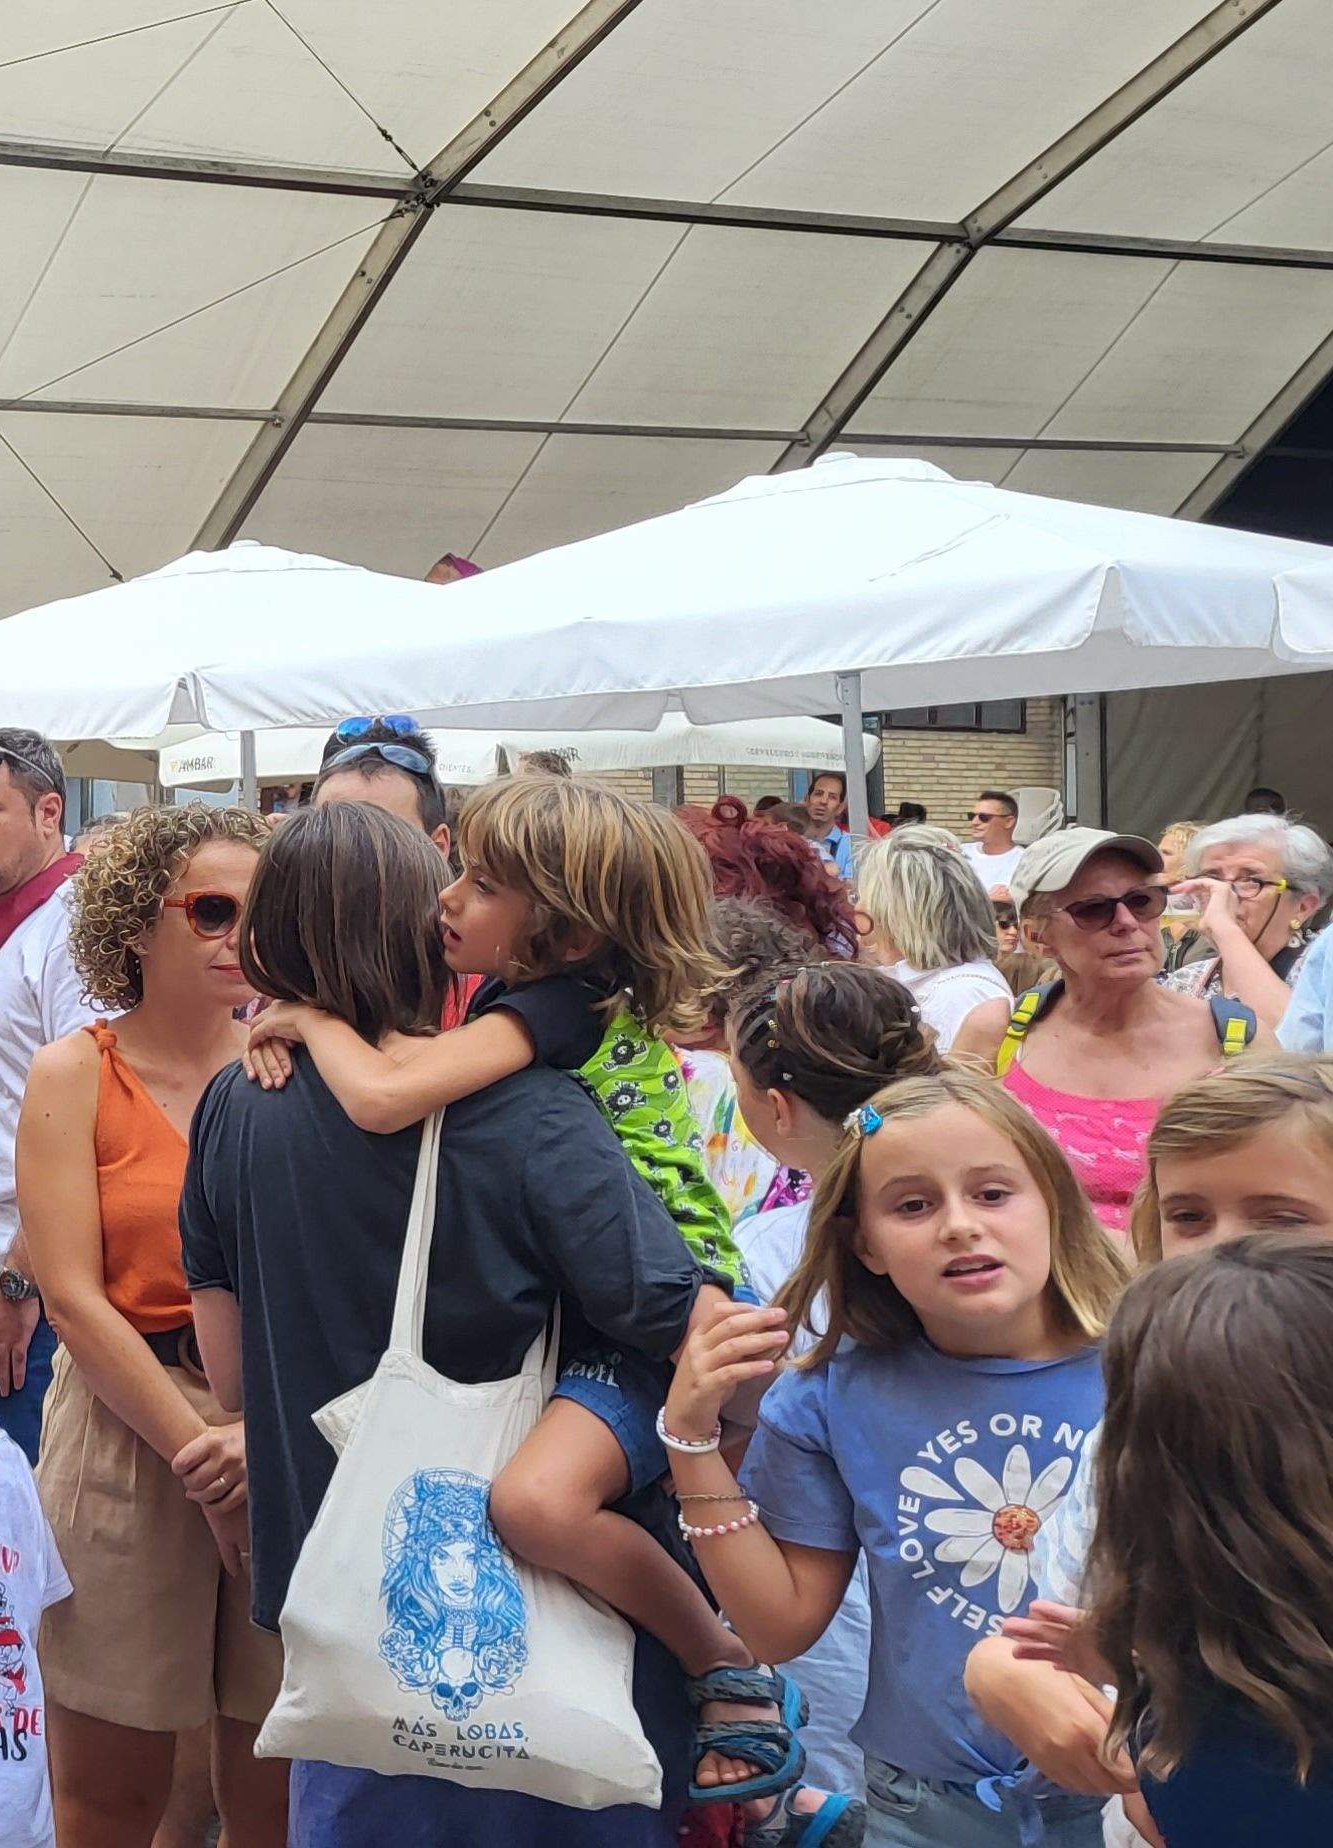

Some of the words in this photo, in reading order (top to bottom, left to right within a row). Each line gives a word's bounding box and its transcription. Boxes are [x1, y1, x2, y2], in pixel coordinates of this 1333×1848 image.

[178, 755, 215, 773] AMBAR
[916, 1420, 979, 1465] YES
[989, 1413, 1043, 1439] OR
[897, 1494, 936, 1581] LOVE
[925, 1585, 1007, 1638] SELF
[13, 1706, 44, 1737] DE
[392, 1715, 438, 1738] MÁS
[392, 1734, 531, 1761] CAPERUCITA
